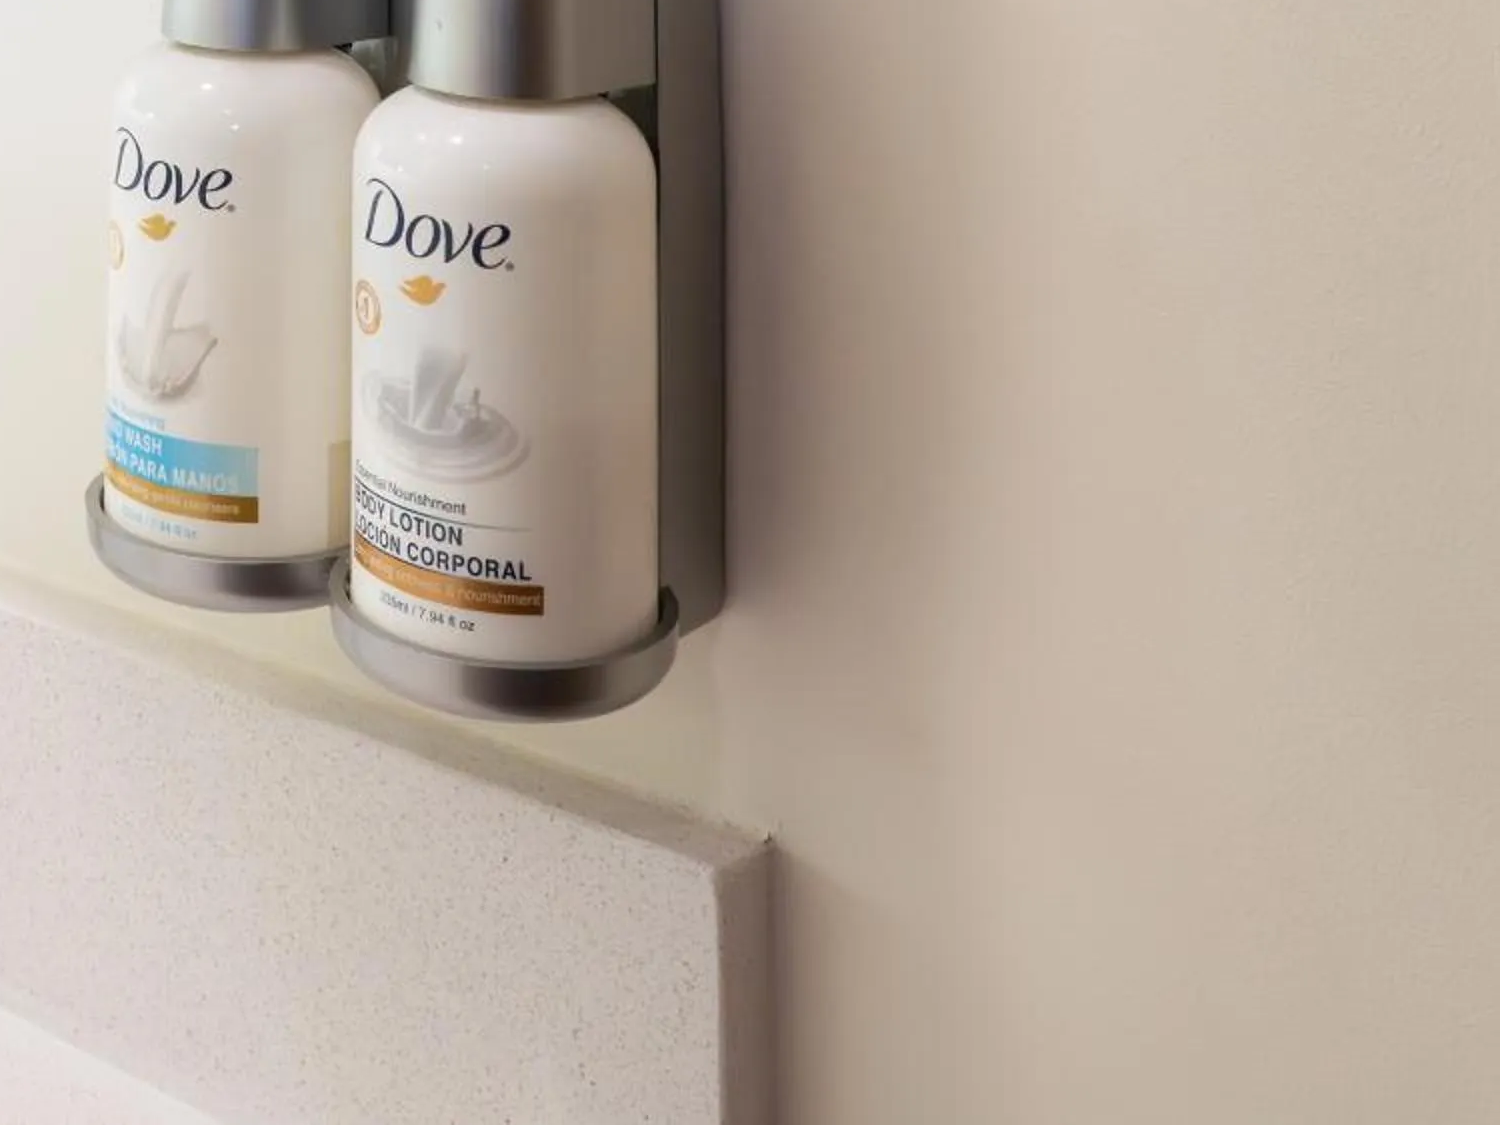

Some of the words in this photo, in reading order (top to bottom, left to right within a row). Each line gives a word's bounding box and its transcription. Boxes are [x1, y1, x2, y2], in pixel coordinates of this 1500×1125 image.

[112, 126, 235, 212] Dove
[364, 177, 513, 269] Dove
[130, 454, 168, 483] PARA
[389, 508, 464, 546] LOTION
[407, 541, 533, 582] CORPORAL
